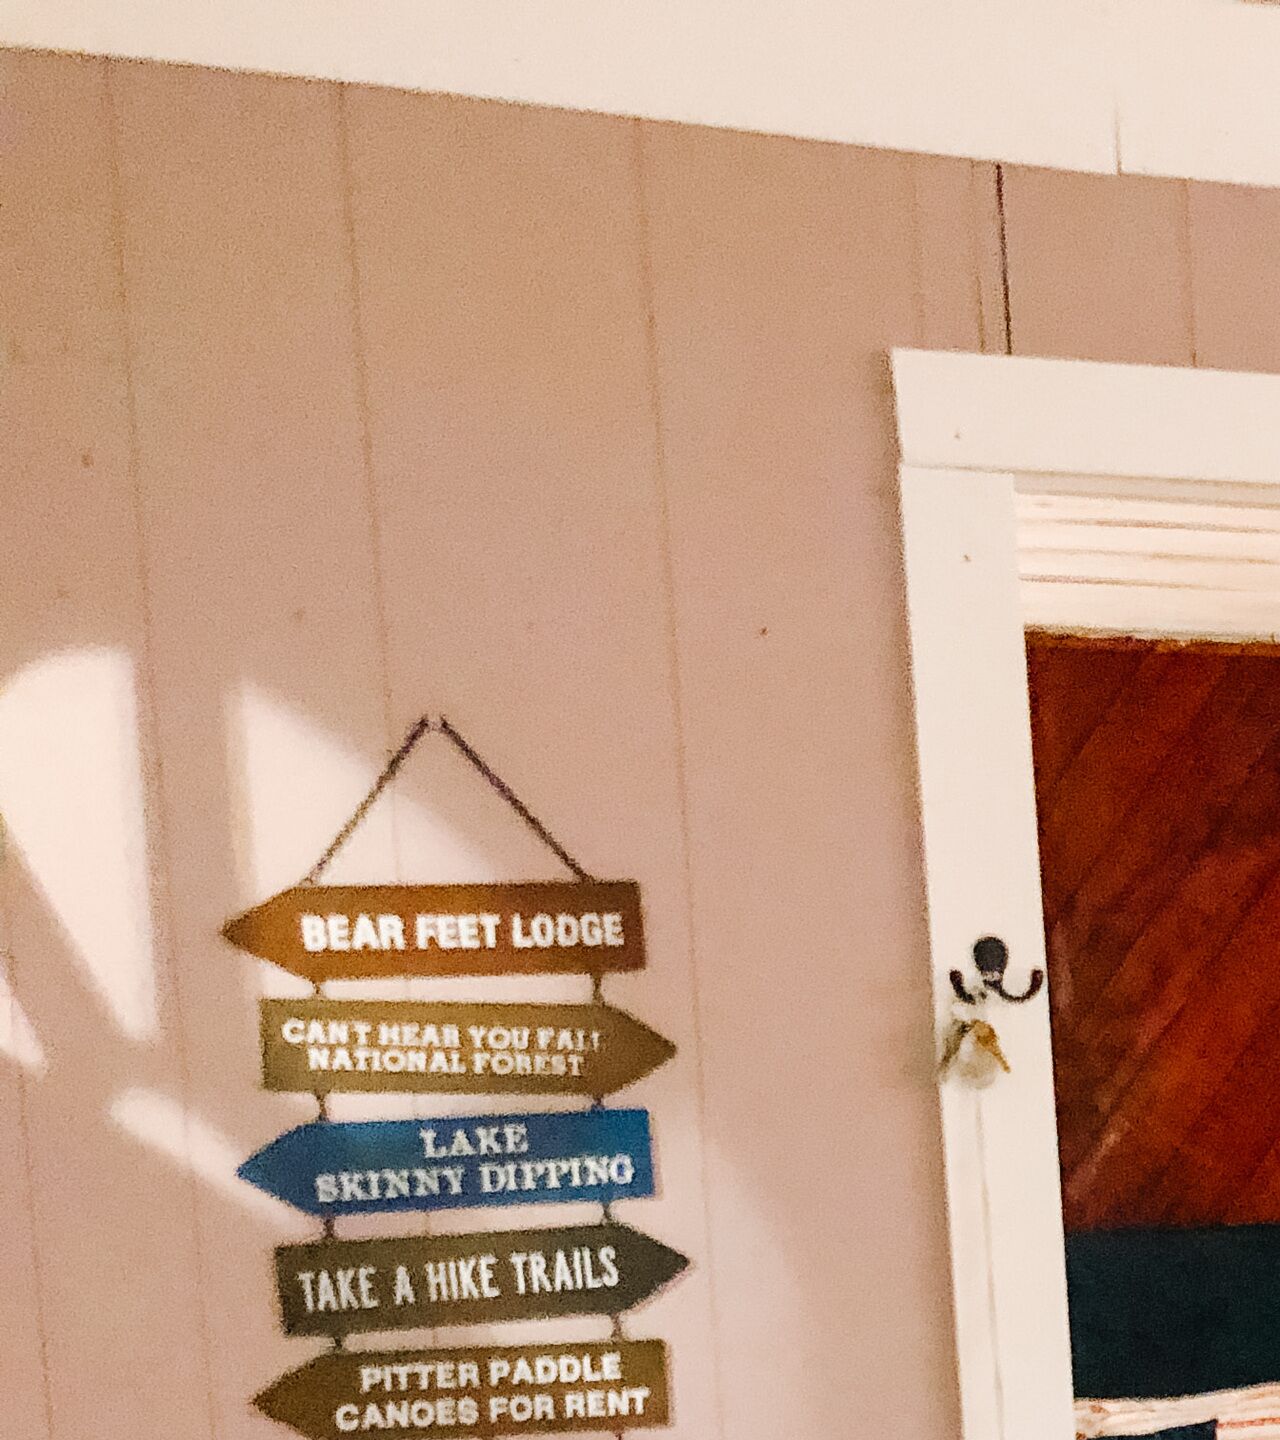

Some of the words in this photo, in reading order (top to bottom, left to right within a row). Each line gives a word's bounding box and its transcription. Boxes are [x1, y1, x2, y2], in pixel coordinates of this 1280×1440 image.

[301, 912, 403, 952] BEAR
[415, 912, 500, 950] FEET
[512, 911, 625, 948] LODGE
[378, 1022, 460, 1048] HEAR
[467, 1024, 530, 1050] YOU
[308, 1047, 467, 1074] NATIONAL
[472, 1050, 586, 1077] FOREST
[419, 1122, 528, 1158] LAKE
[314, 1166, 466, 1203] SKINNY
[479, 1153, 635, 1193] DIPPING
[299, 1266, 378, 1314] TAKE
[393, 1265, 415, 1306] A
[425, 1255, 499, 1302] HIKE
[511, 1246, 620, 1296] TRAILS
[360, 1361, 481, 1394] PITTER
[487, 1351, 622, 1386] PADDLE
[334, 1397, 480, 1433] CANOES
[489, 1393, 555, 1424] FOR
[564, 1386, 651, 1418] RENT
